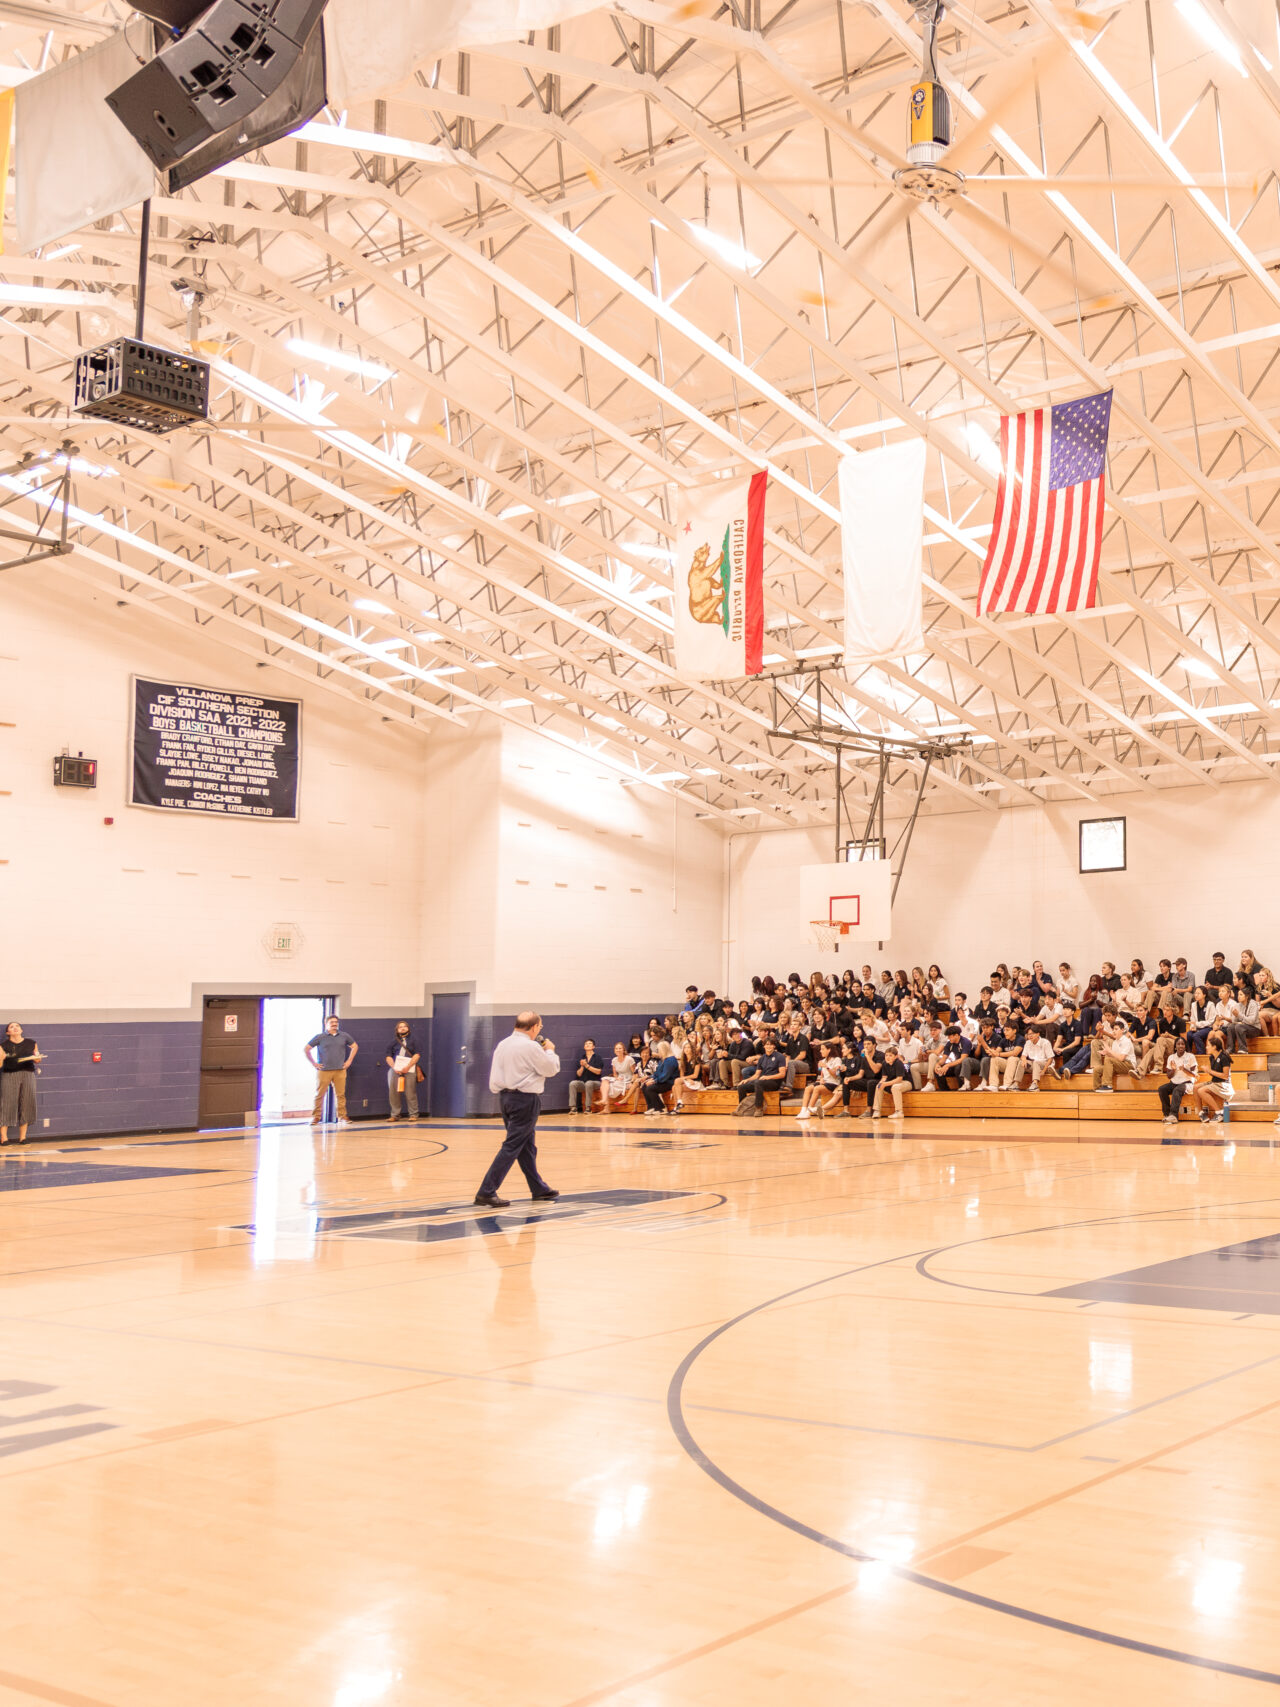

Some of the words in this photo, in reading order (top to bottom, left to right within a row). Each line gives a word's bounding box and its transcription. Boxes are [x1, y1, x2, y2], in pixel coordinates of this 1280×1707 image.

[176, 688, 232, 703] VILLANOVA
[236, 696, 263, 707] PREP
[158, 694, 175, 706] CIF
[178, 697, 234, 714] SOUTHERN
[237, 705, 280, 720] SECTION
[150, 704, 195, 720] DIVISION
[199, 710, 220, 723] 5AA
[226, 714, 286, 732] 2021-2022
[153, 716, 176, 729] BOYS
[180, 720, 235, 737] BASKETBALL
[239, 728, 283, 743] CHAMPIONS
[162, 740, 182, 750] FRANK
[156, 757, 176, 767] FRANK
[194, 792, 242, 804] COACHES
[277, 937, 292, 949] EXIT
